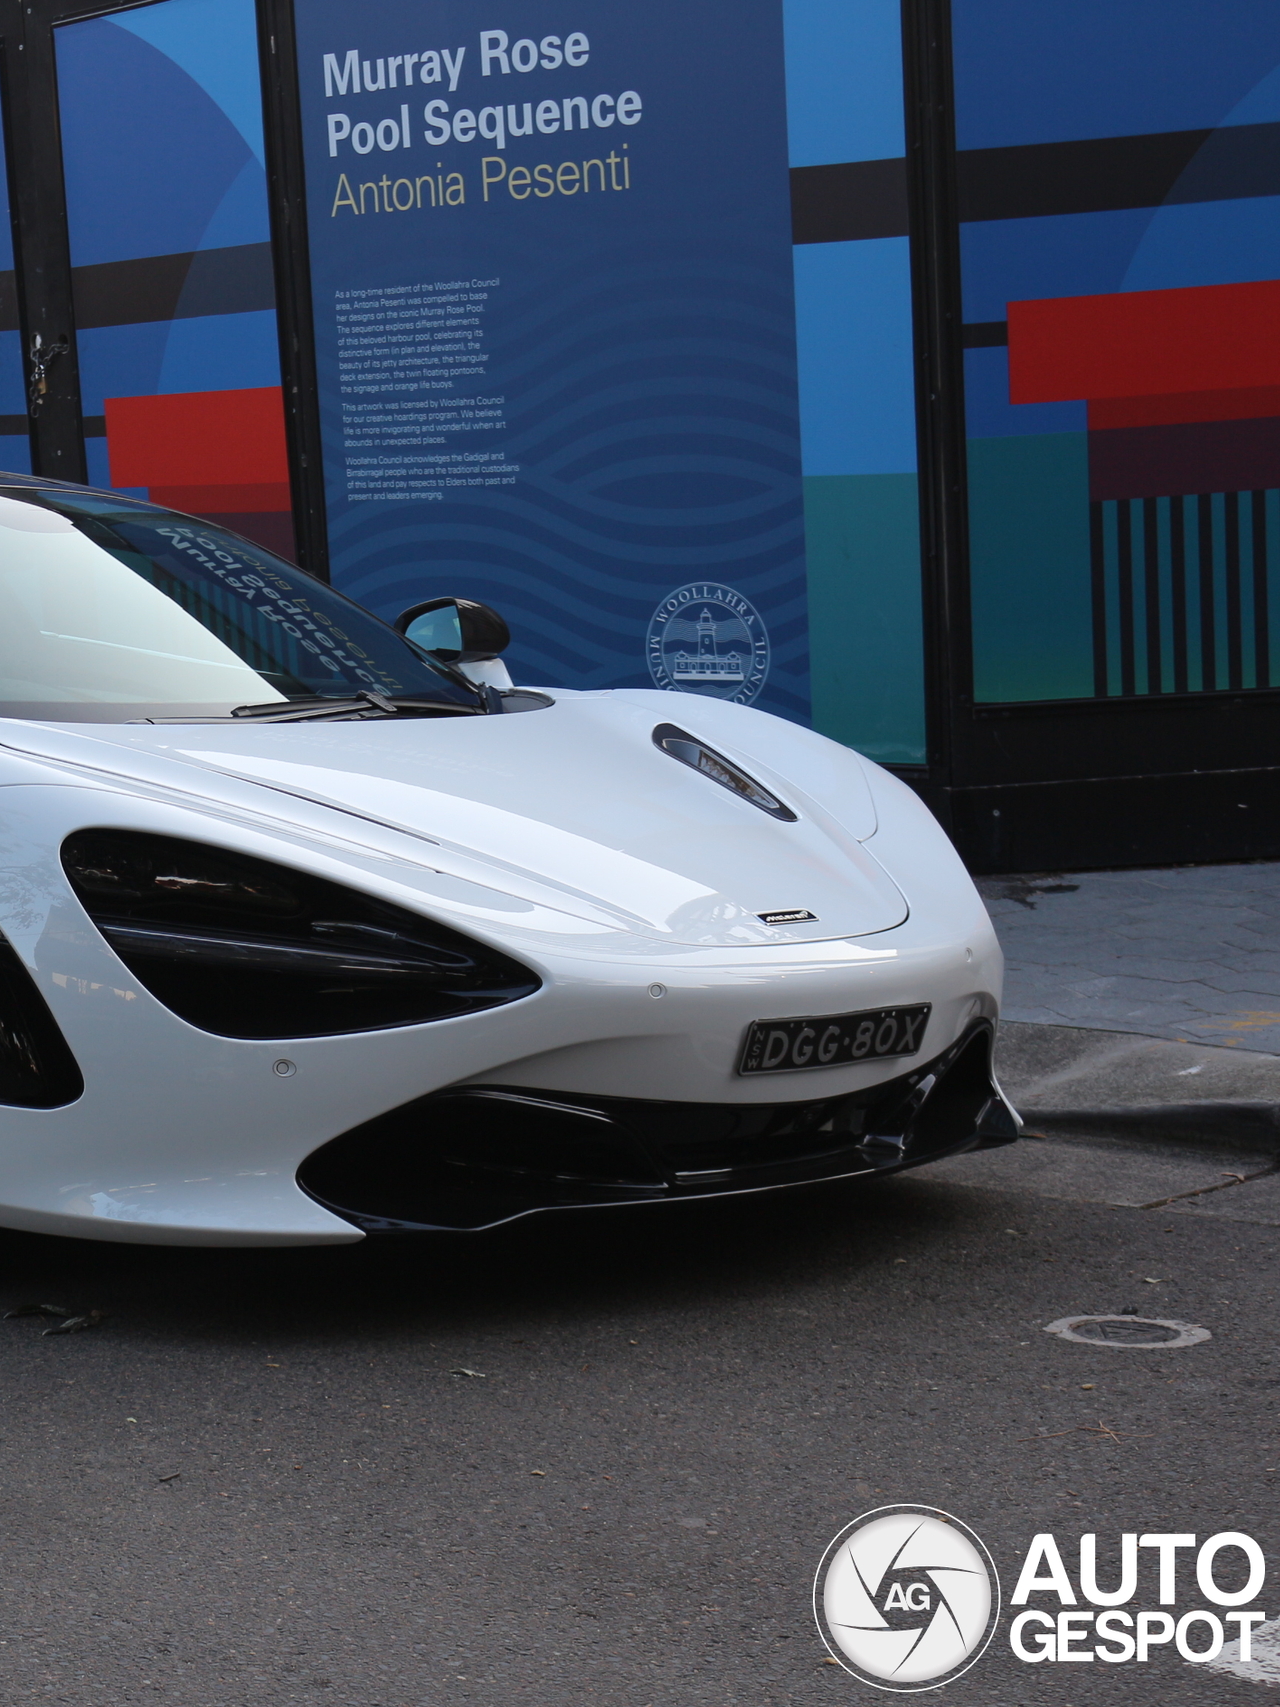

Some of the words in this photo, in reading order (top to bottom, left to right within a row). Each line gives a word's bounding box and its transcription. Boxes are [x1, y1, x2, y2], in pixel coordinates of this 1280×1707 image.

[323, 47, 466, 97] Murray
[480, 29, 589, 76] Rose
[327, 104, 411, 157] Pool
[424, 90, 642, 149] Sequence
[331, 162, 465, 217] Antonia
[482, 143, 630, 201] Pesenti
[336, 290, 344, 298] As
[351, 287, 382, 299] long-time
[384, 285, 411, 295] resident
[412, 284, 420, 293] of
[422, 284, 433, 292] the
[435, 281, 469, 291] Woollahra
[471, 279, 500, 288] Council
[353, 299, 379, 309] Antonia
[380, 298, 405, 307] Pesenti
[422, 294, 458, 305] compelled
[460, 293, 467, 301] to
[469, 292, 488, 301] base
[337, 314, 347, 322] her
[348, 312, 374, 322] designs
[386, 310, 397, 318] the
[398, 309, 418, 318] iconic
[420, 307, 444, 318] Murray
[446, 306, 464, 314] Rose
[466, 304, 485, 313] Pool.
[338, 326, 349, 334] The
[351, 325, 383, 334] sequence
[385, 321, 414, 332] explores
[415, 319, 444, 328] different
[445, 317, 479, 326] elements
[338, 338, 344, 346] of
[346, 337, 358, 345] this
[359, 335, 386, 344] beloved
[387, 334, 413, 342] harbour
[433, 330, 472, 341] celebrating
[473, 329, 483, 337] its
[339, 348, 372, 357] distinctive
[373, 347, 389, 355] form
[400, 345, 415, 355] plan
[416, 344, 429, 352] and
[467, 341, 480, 349] the
[339, 360, 361, 370] beauty
[363, 360, 370, 368] of
[371, 359, 380, 367] its
[381, 358, 396, 368] jetty
[442, 355, 453, 363] the
[455, 353, 489, 364] triangular
[340, 373, 355, 381] deck
[393, 370, 404, 378] the
[406, 370, 421, 378] twin
[423, 368, 448, 378] floating
[341, 385, 351, 393] the
[353, 384, 379, 394] signage
[380, 383, 393, 391] and
[394, 383, 418, 392] orange
[419, 381, 430, 389] life
[431, 380, 454, 390] buoys.
[342, 403, 356, 411] This
[357, 402, 382, 410] artwork
[400, 400, 428, 408] licensed
[429, 399, 438, 408] by
[440, 398, 474, 406] Woollahra
[476, 396, 504, 405] Council
[345, 438, 372, 446] abounds
[381, 436, 421, 447] unexpected
[422, 435, 447, 445] places.
[656, 586, 755, 626] WOOLLAHRA
[734, 636, 766, 704] OUNCIL
[766, 910, 808, 922] McLaren
[748, 1031, 766, 1069] NSW
